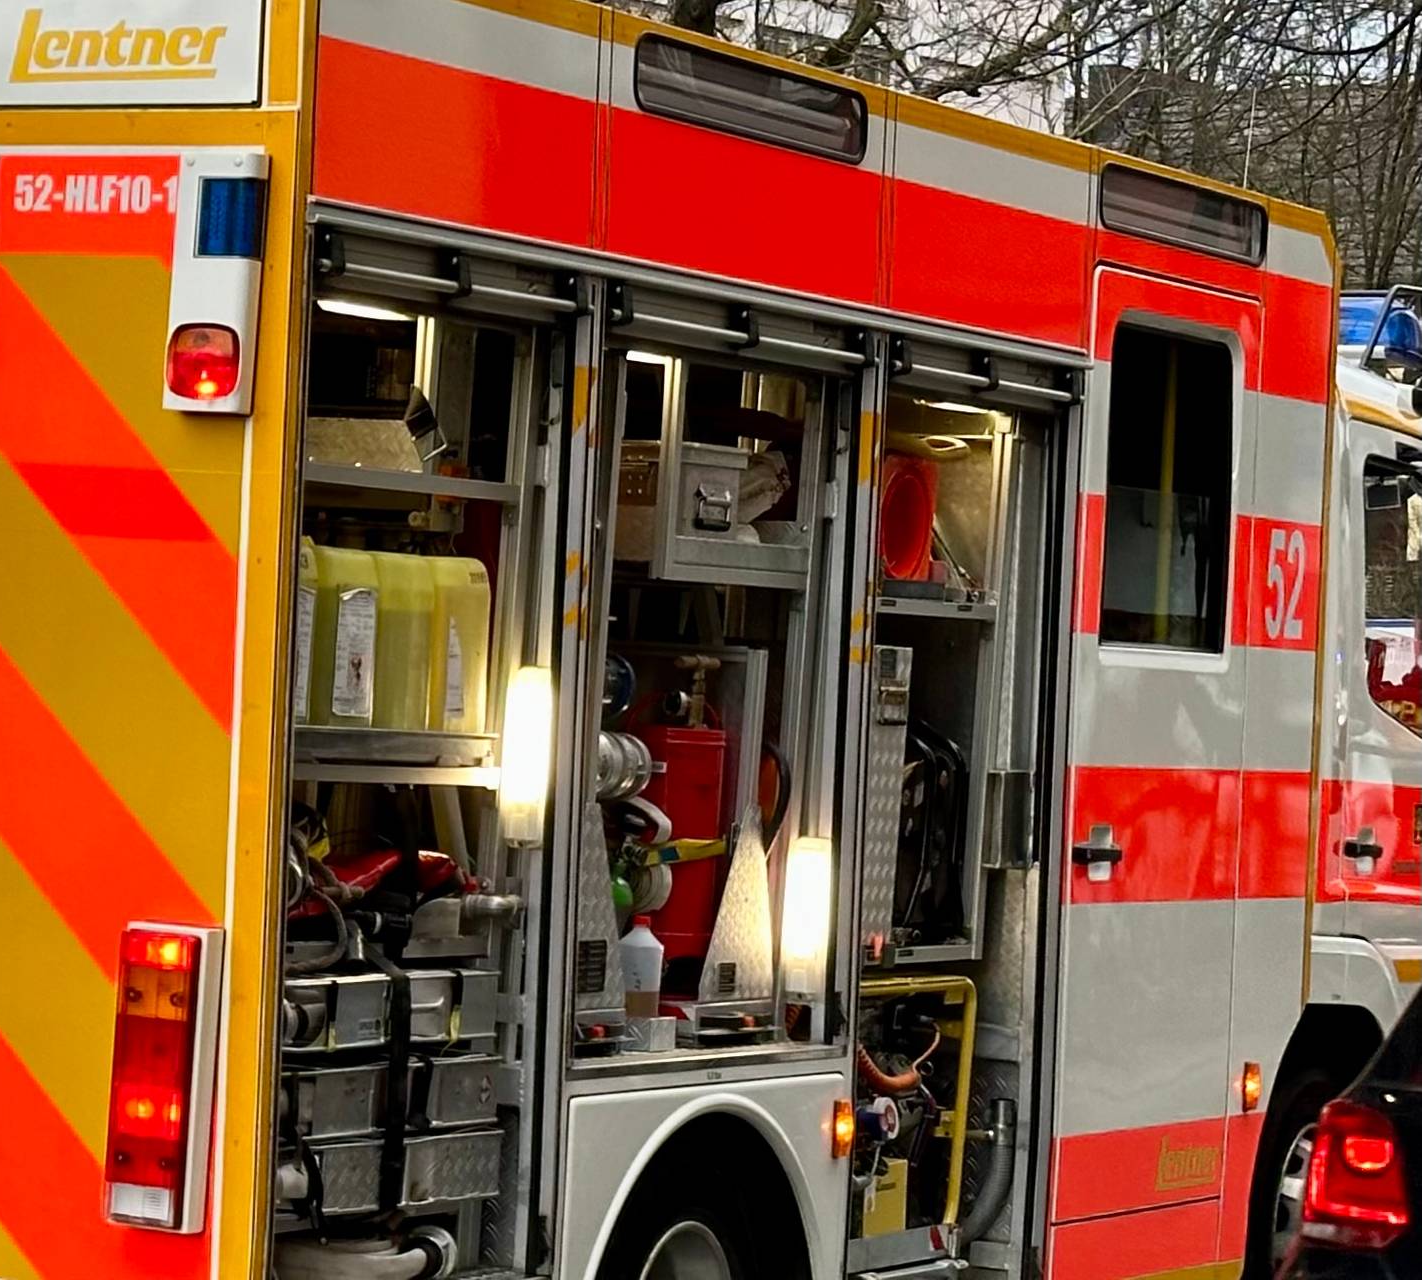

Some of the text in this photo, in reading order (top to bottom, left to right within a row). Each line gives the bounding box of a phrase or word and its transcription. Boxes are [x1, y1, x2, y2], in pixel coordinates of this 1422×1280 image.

[9, 8, 227, 83] Lentner
[13, 174, 178, 214] 52-HLF10-1
[1264, 528, 1305, 640] 52
